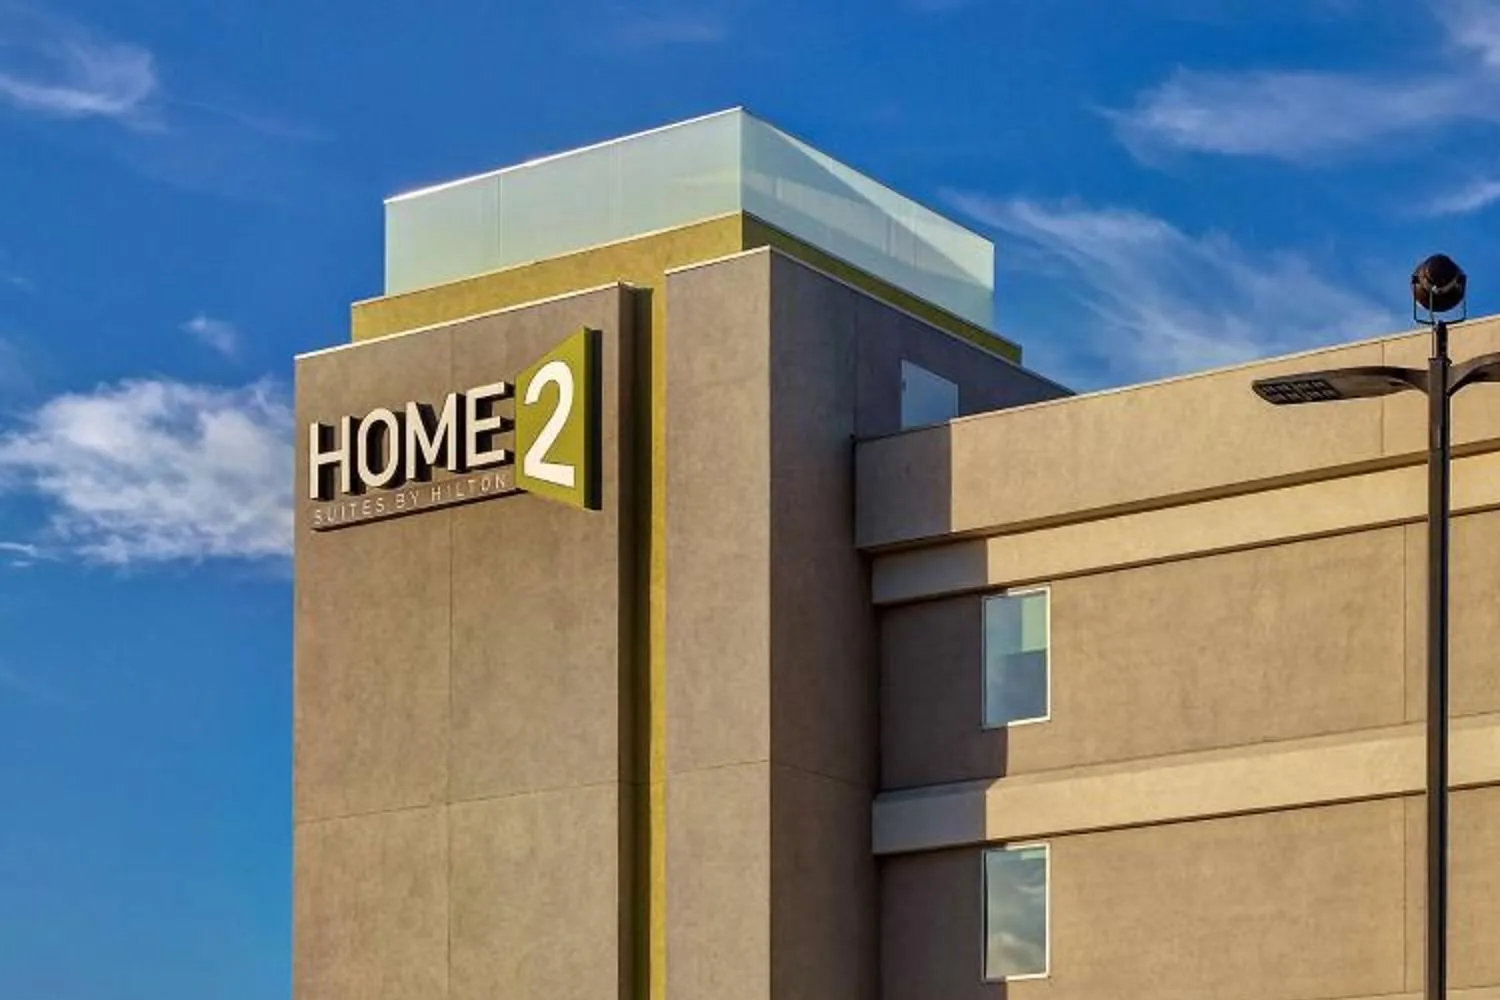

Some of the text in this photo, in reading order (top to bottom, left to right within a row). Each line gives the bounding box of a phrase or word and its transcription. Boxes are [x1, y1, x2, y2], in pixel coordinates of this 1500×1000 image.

[309, 360, 576, 499] HOME 2
[313, 473, 507, 525] SUITES BY HILTON
